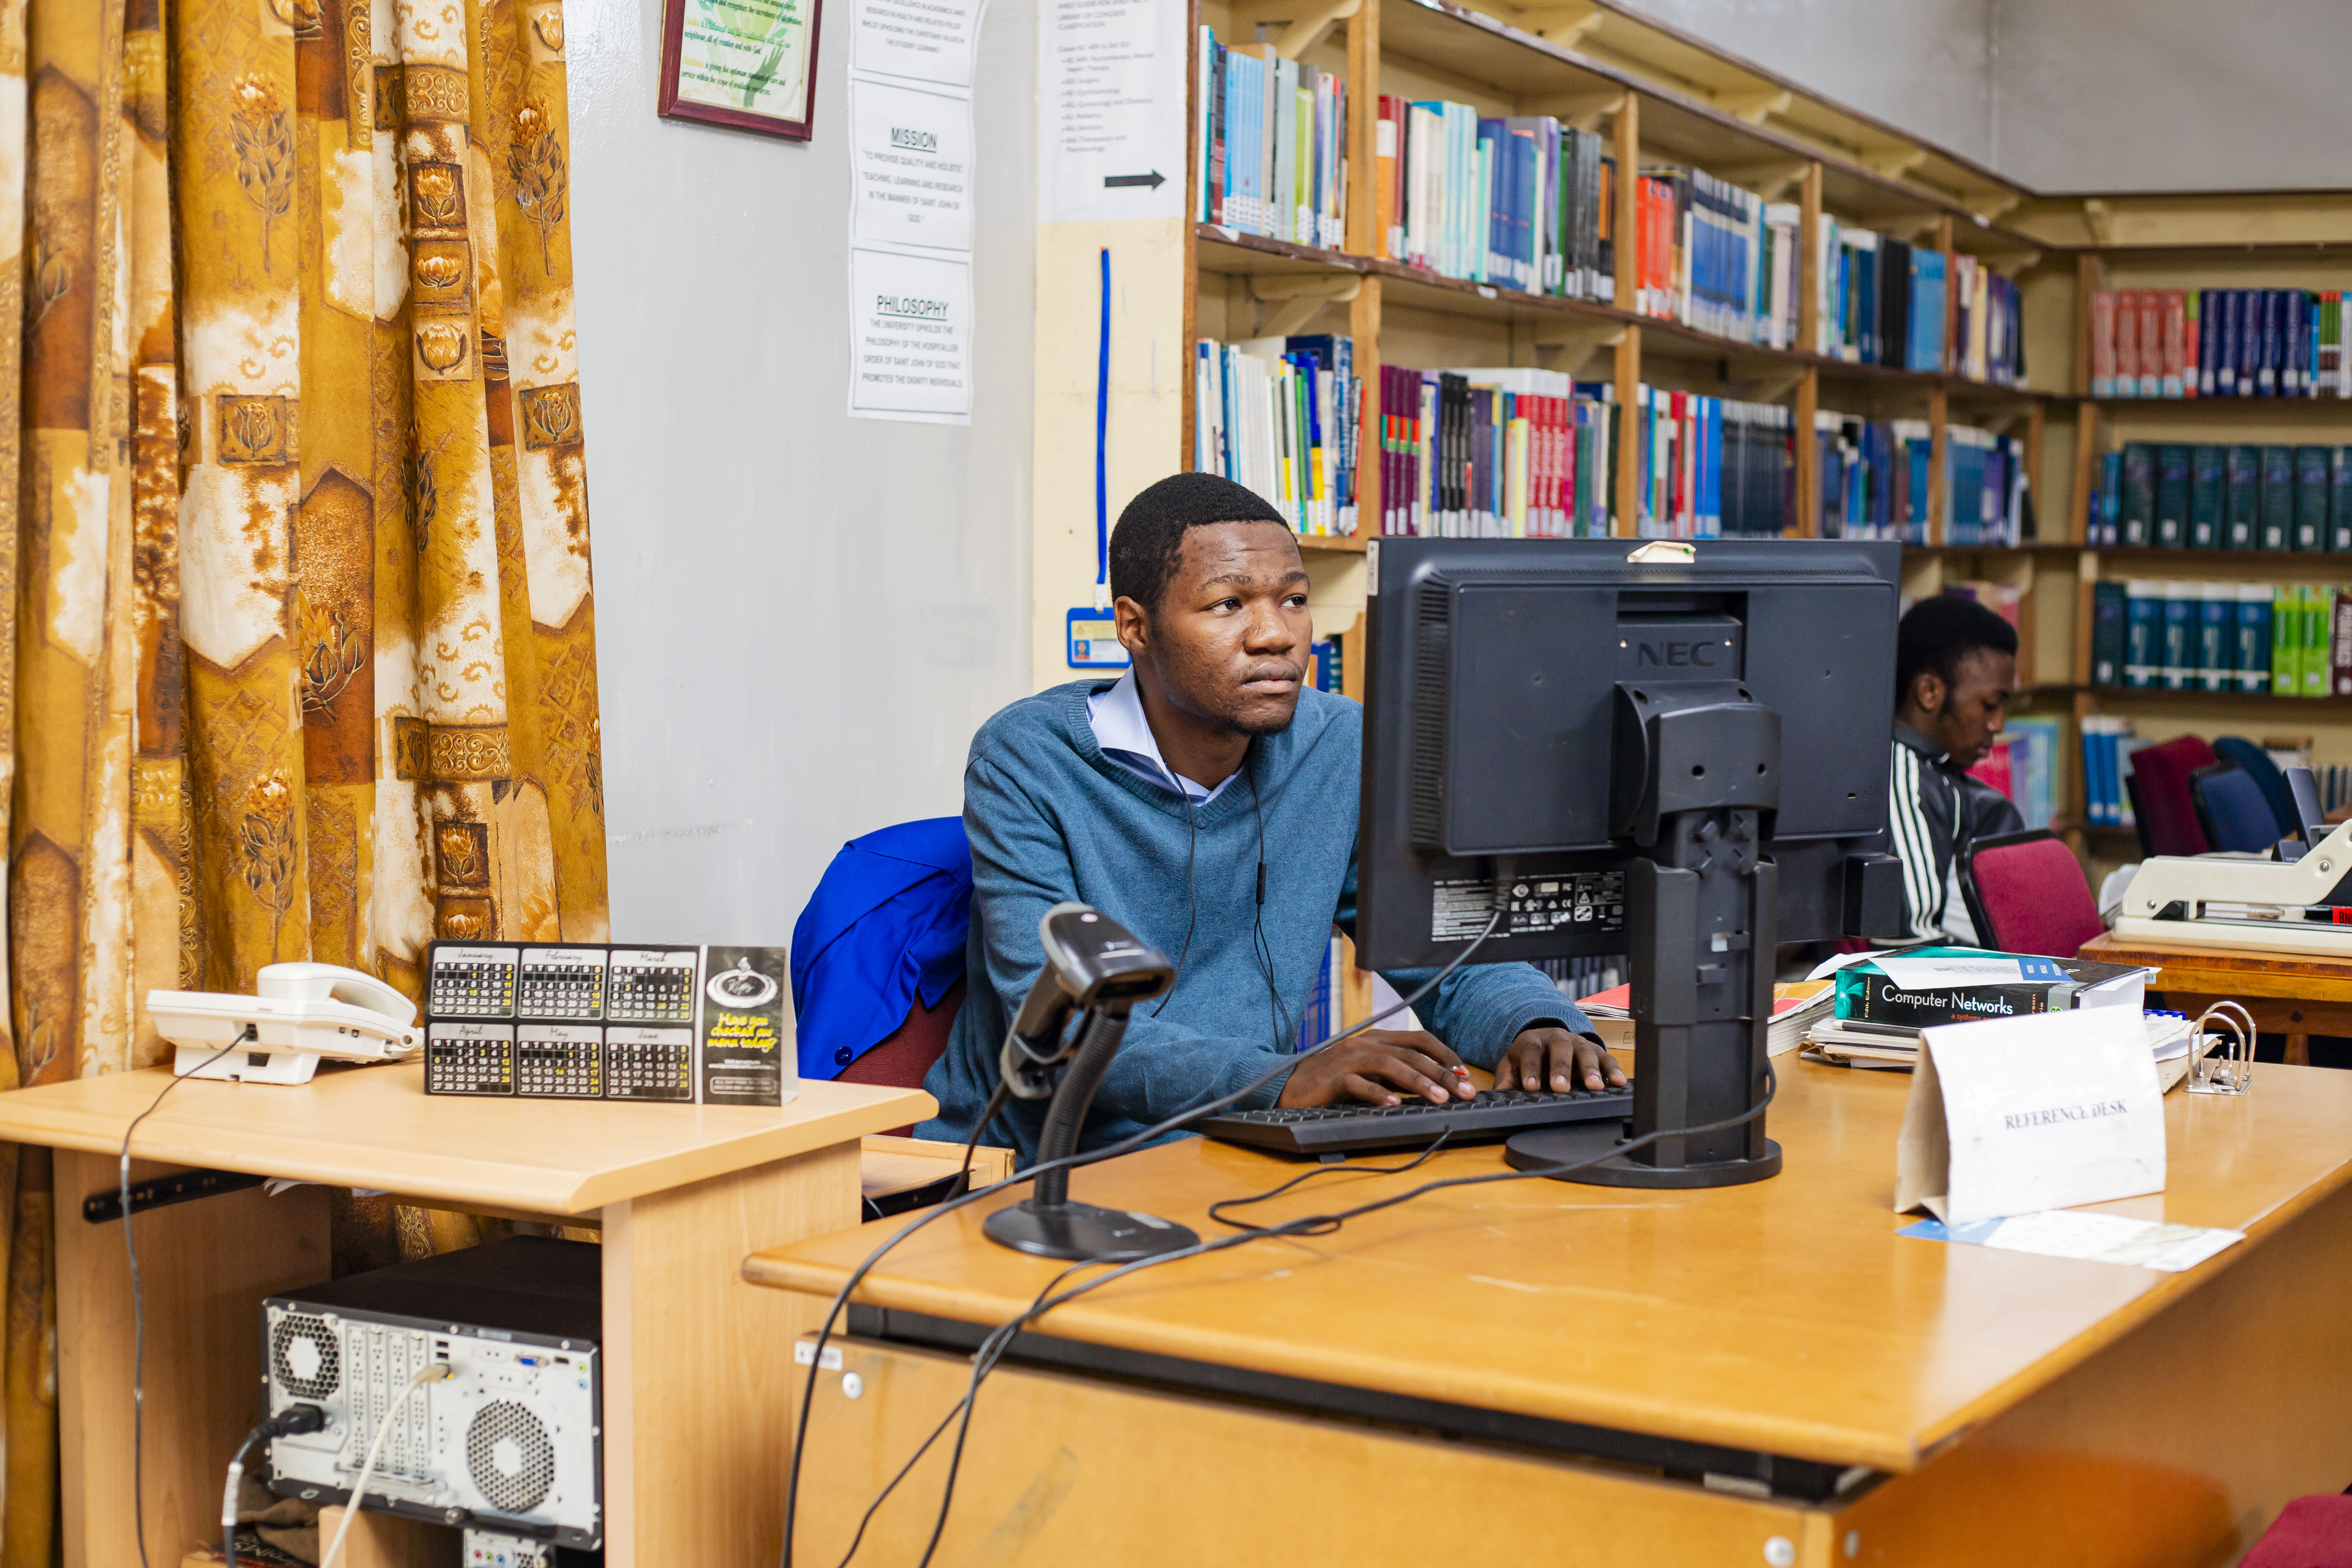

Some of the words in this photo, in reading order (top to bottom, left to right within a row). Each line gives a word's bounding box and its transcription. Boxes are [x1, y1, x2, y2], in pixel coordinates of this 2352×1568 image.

[713, 37, 719, 46] of
[709, 61, 722, 74] giving
[681, 70, 695, 79] service
[696, 72, 709, 81] within
[717, 78, 728, 88] scope
[728, 80, 734, 89] of
[891, 127, 938, 148] MISSION
[874, 152, 899, 163] PROVIDE
[900, 156, 923, 166] QUALITY
[925, 161, 936, 169] AND
[938, 162, 962, 173] HOLISTIC
[893, 176, 921, 187] LEARNING
[935, 182, 963, 192] RESEARCH
[868, 190, 874, 199] IN
[876, 191, 887, 200] THE
[888, 194, 910, 203] MANNER
[911, 196, 919, 205] OF
[920, 197, 936, 206] SAINT
[938, 200, 951, 208] JOHN
[877, 295, 949, 317] PHILOSOPHY
[870, 318, 881, 328] THE
[883, 320, 914, 330] UNIVERSITY
[916, 323, 941, 333] UPHOLDS
[943, 326, 954, 334] THE
[865, 336, 900, 346] PHILOSOPHY
[901, 339, 909, 348] OF
[910, 340, 921, 349] THE
[922, 342, 958, 352] HOSPITALLER
[864, 354, 883, 364] ORDER
[884, 356, 892, 364] OF
[893, 357, 909, 365] SAINT
[911, 358, 925, 367] JOHN
[948, 361, 961, 369] THAT
[862, 372, 893, 383] PROMOTES
[895, 375, 905, 383] THE
[906, 376, 927, 384] DIGNITY
[929, 378, 962, 387] INDIVIDUALS
[1638, 641, 1715, 668] NEC
[458, 949, 493, 962] January
[545, 950, 583, 963] February
[640, 951, 667, 961] March
[1882, 985, 1948, 1009] Computer
[1952, 991, 2013, 1015] Networks
[718, 1012, 748, 1026] Have
[749, 1016, 769, 1026] you
[459, 1025, 483, 1037] April
[550, 1026, 569, 1041] May
[638, 1030, 658, 1039] June
[710, 1024, 756, 1037] checked
[756, 1028, 774, 1038] our
[707, 1038, 739, 1047] menu
[740, 1037, 778, 1053] today?
[2005, 1105, 2088, 1130] REFERENCE
[2092, 1099, 2128, 1118] DESK
